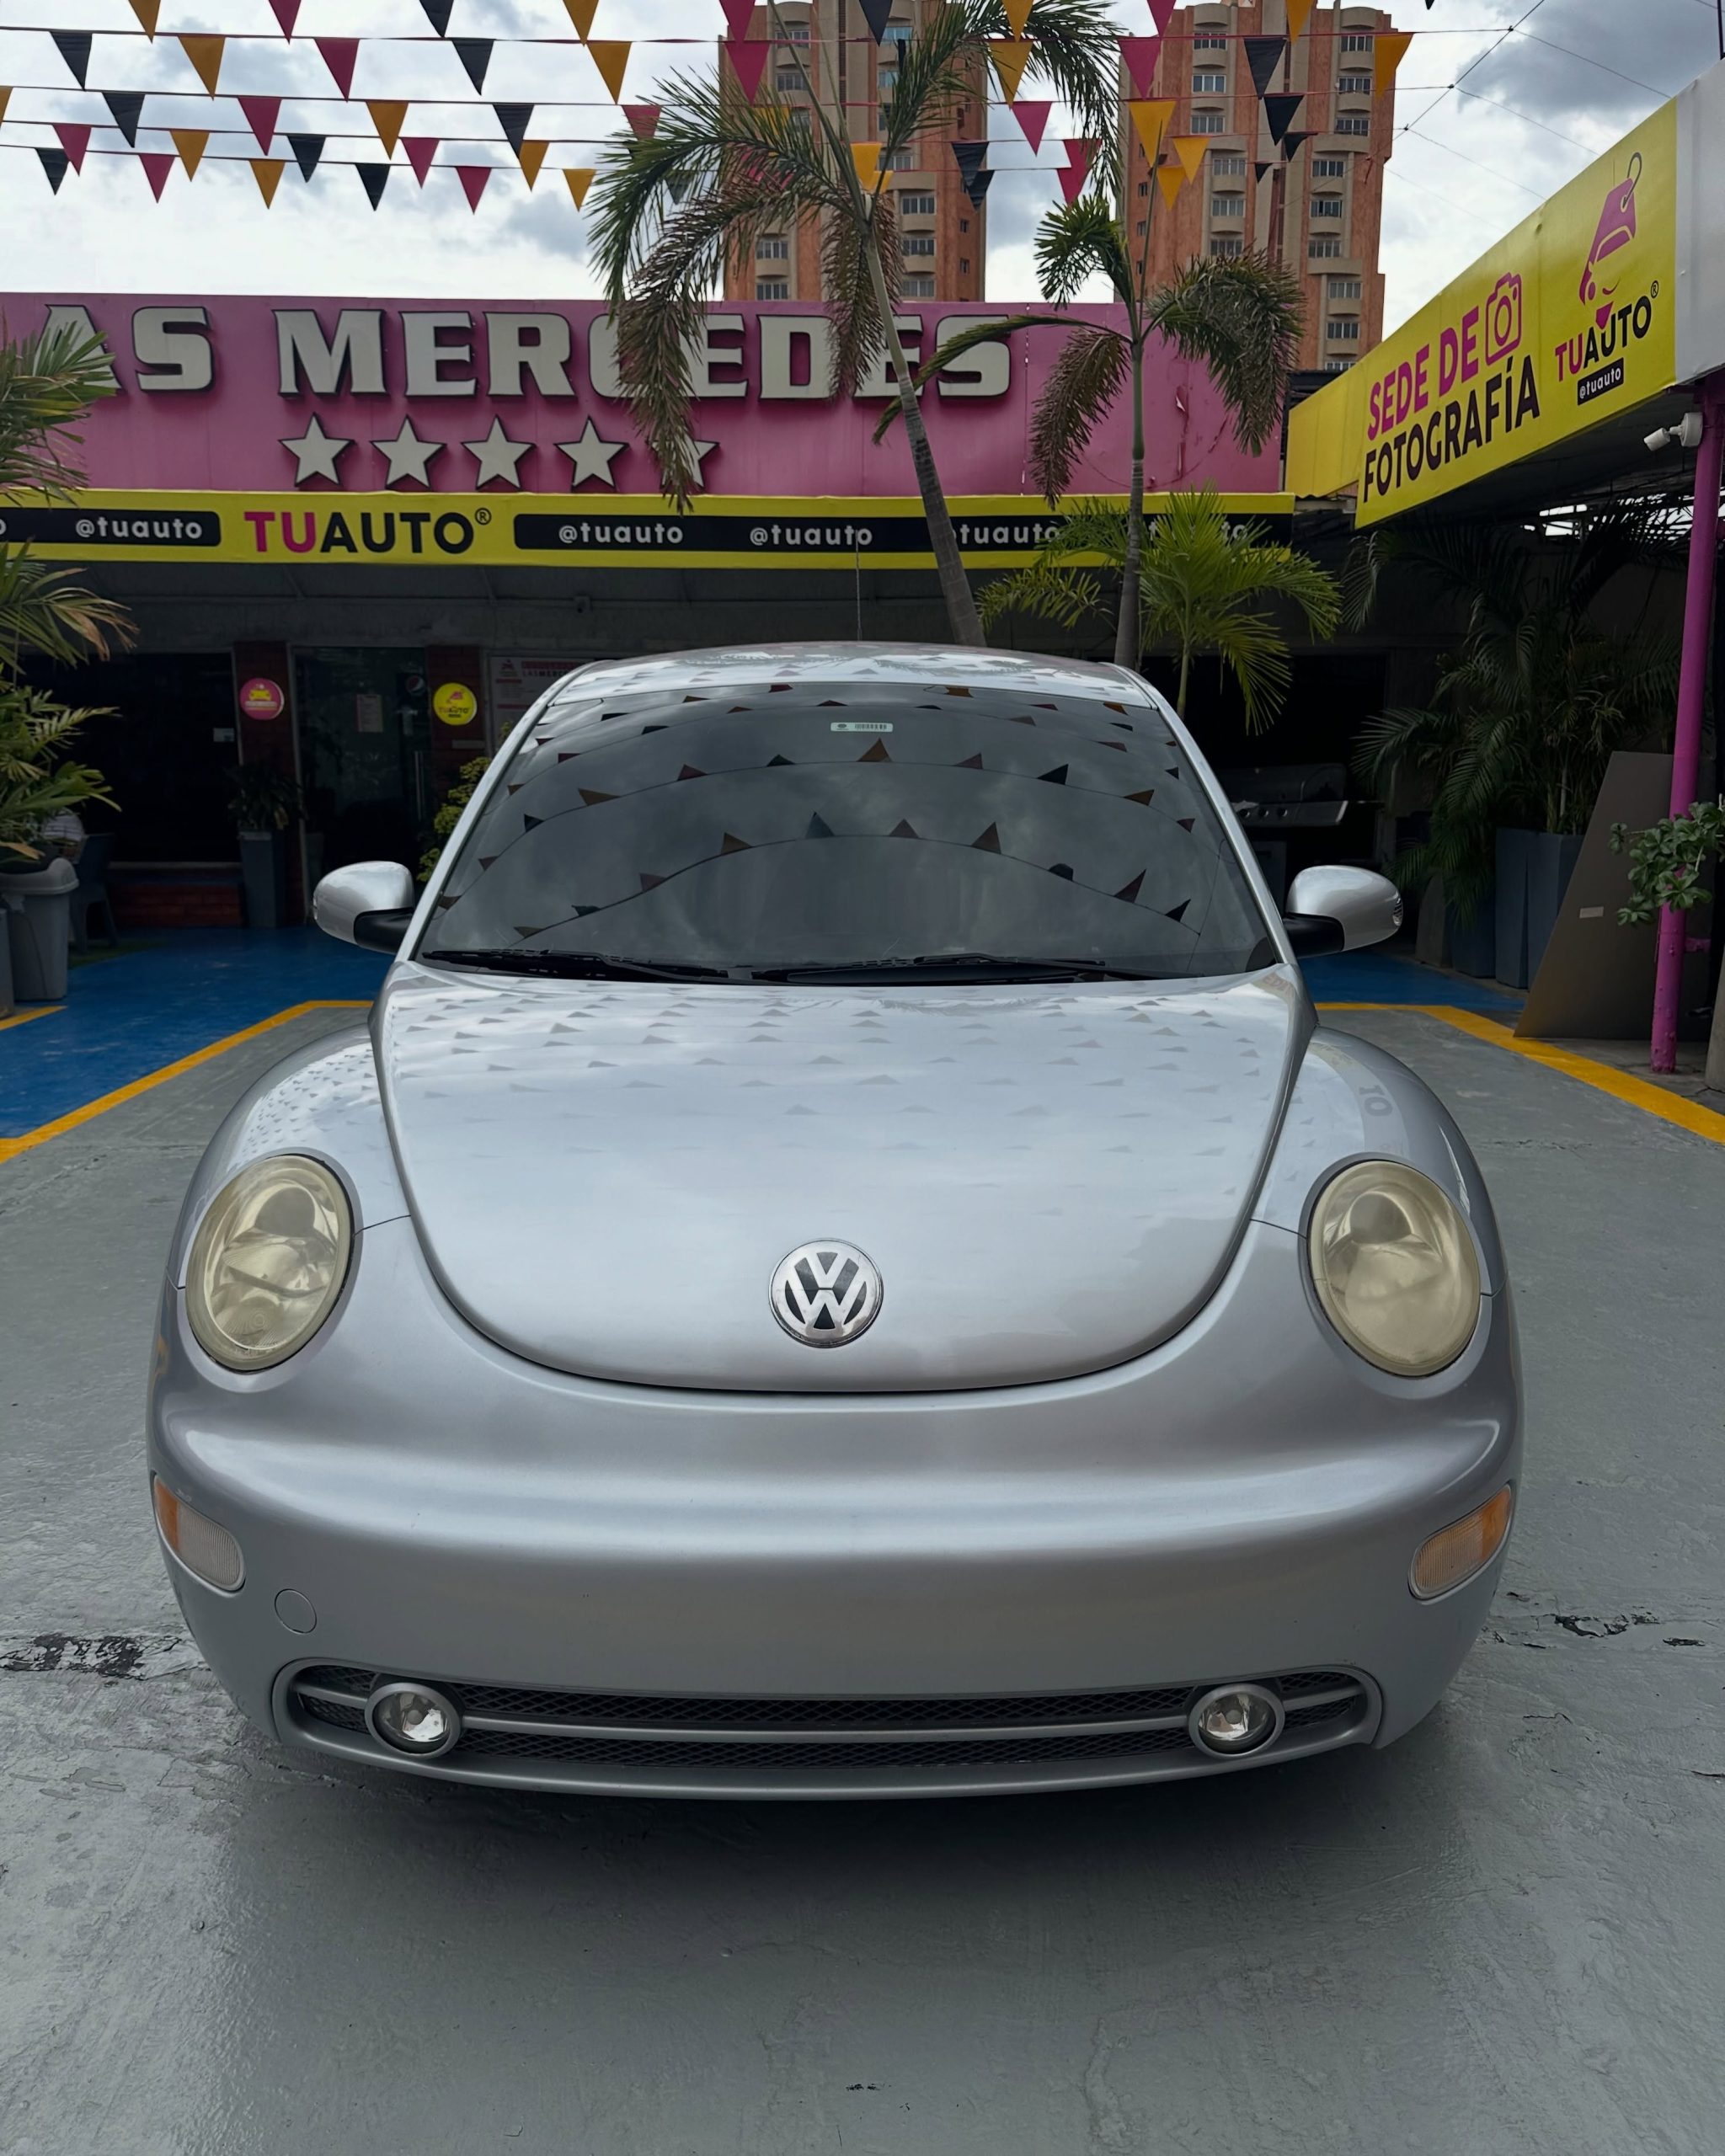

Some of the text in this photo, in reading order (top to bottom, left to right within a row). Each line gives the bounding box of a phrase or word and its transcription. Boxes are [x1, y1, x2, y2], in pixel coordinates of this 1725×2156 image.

[32, 304, 215, 392] AS
[1368, 306, 1479, 441] SEDE DE
[1579, 367, 1621, 398] @tuauto
[1363, 355, 1541, 504] FOTOGRAFÍA
[75, 515, 203, 540] @tuauto
[558, 522, 684, 544] @tuauto
[750, 524, 873, 546] @tuauto
[953, 523, 1060, 545] tuauto
[777, 1245, 875, 1337] VW
